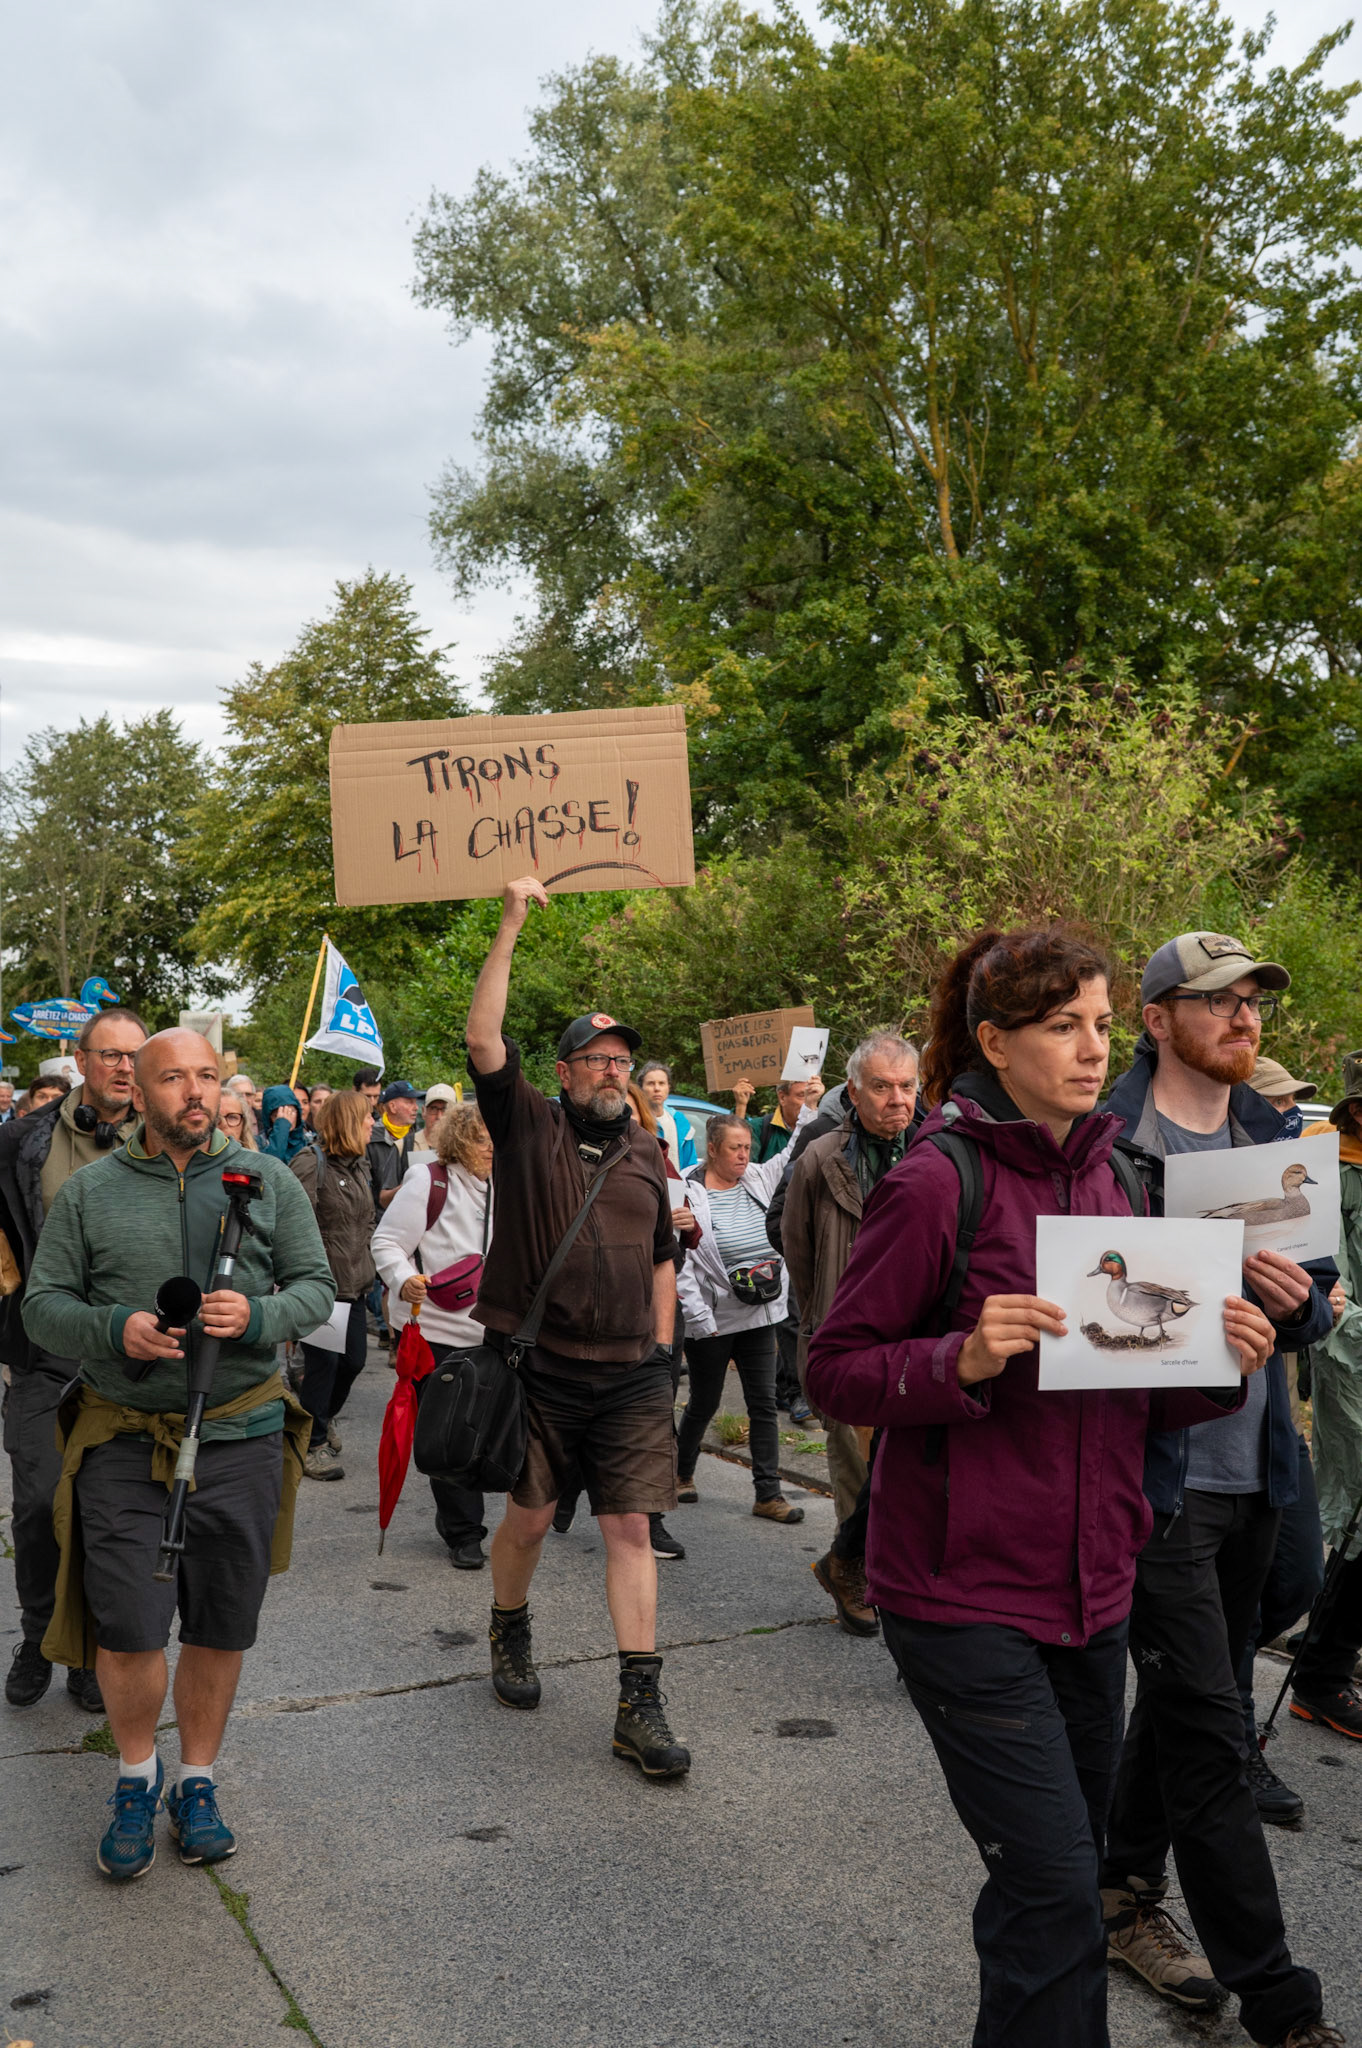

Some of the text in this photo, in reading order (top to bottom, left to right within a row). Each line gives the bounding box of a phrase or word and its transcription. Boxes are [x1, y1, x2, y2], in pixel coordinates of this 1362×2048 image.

[392, 818, 439, 862] LA
[714, 1021, 751, 1039] J'AIME
[717, 1033, 778, 1052] CHASSEURS
